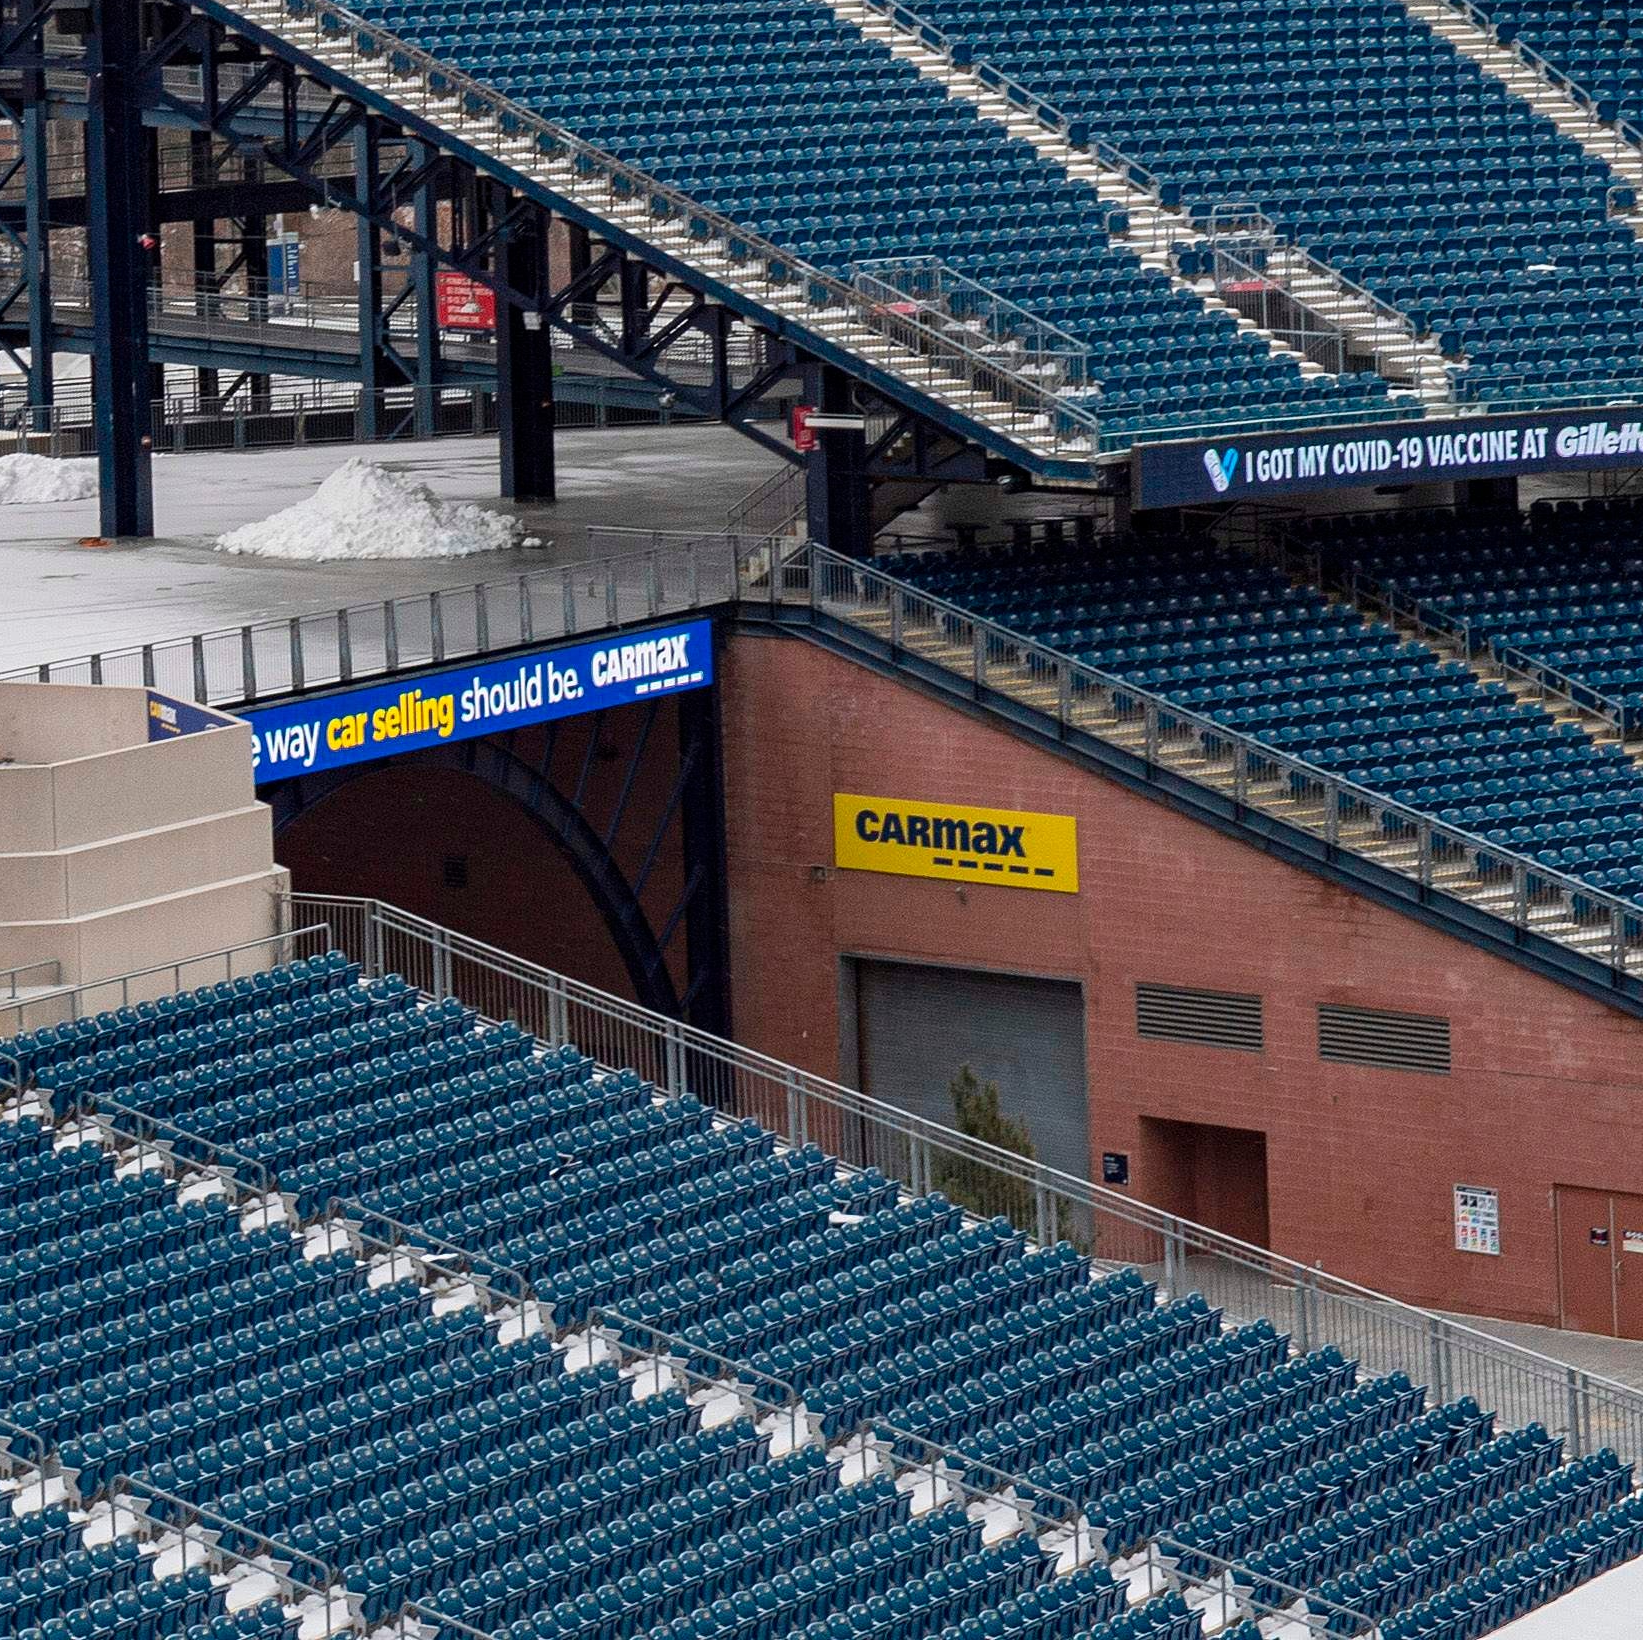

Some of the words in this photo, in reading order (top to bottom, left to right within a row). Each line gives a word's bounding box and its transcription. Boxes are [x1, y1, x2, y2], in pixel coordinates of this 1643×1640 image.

[1245, 451, 1253, 482] I
[1256, 448, 1294, 481] GOT
[1298, 445, 1329, 478] MY
[1332, 437, 1423, 475] COVID-19
[1426, 429, 1518, 467] VACCINE
[1522, 427, 1549, 460] AT
[1555, 422, 1643, 458] Gillett
[265, 720, 321, 767] way
[325, 708, 367, 752] car
[372, 689, 454, 742] selling
[460, 663, 542, 722] should
[547, 662, 583, 700] be.
